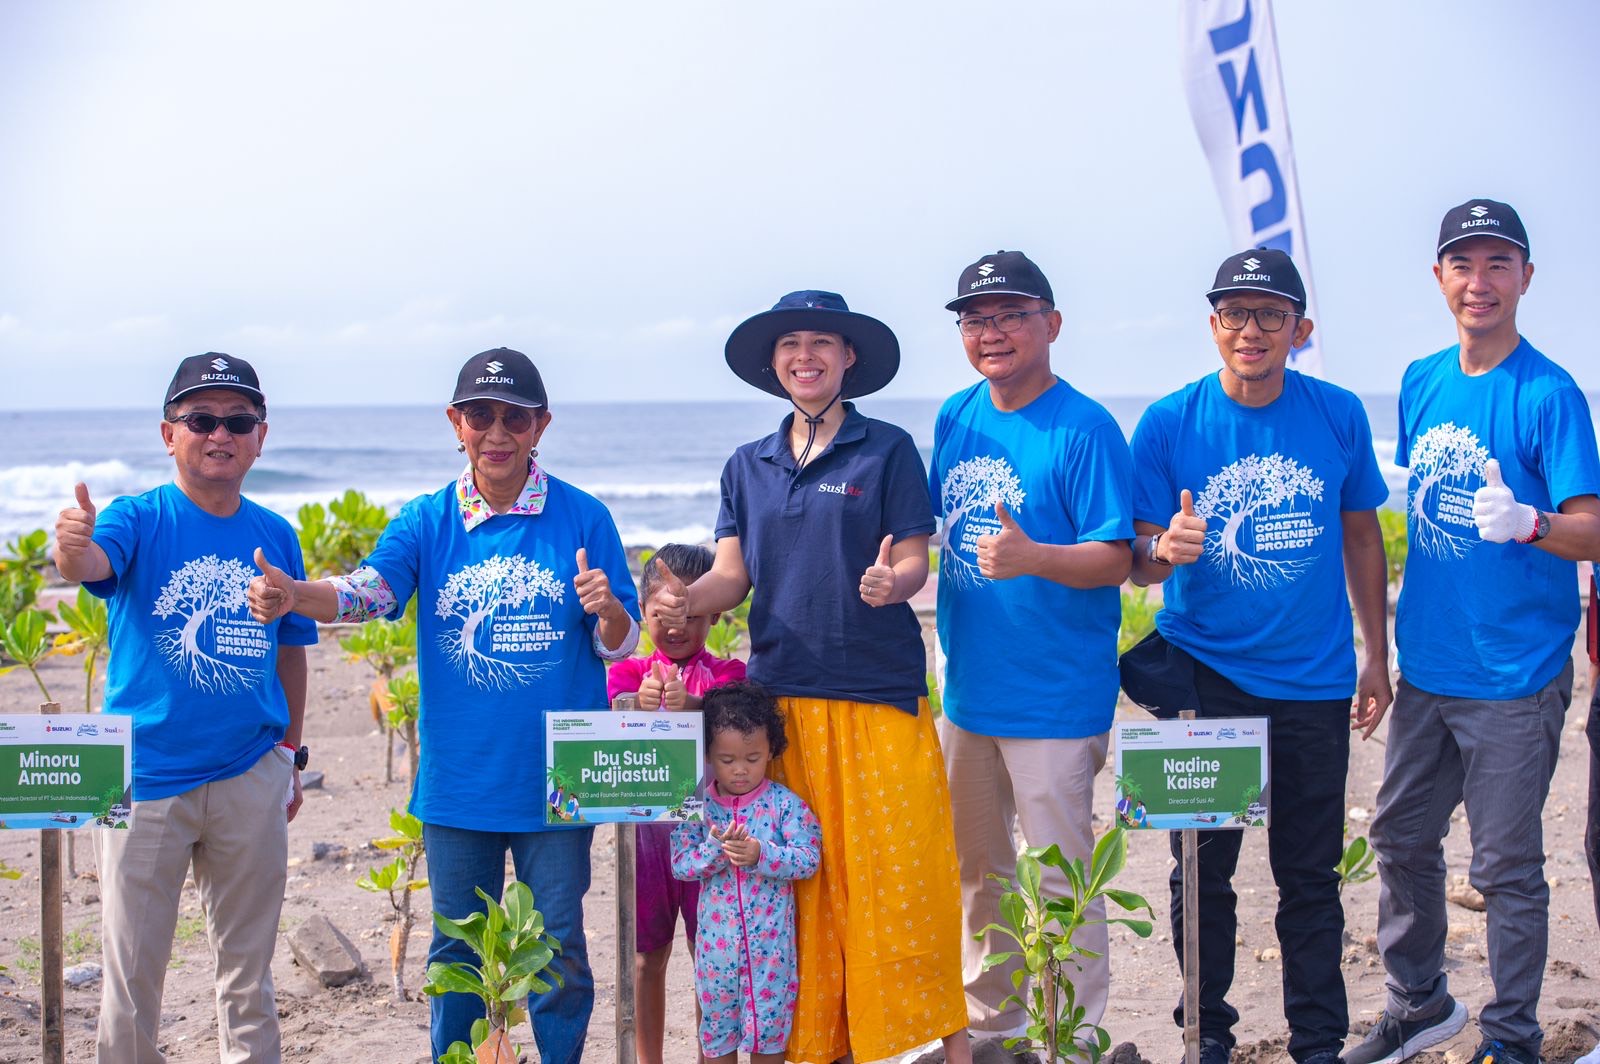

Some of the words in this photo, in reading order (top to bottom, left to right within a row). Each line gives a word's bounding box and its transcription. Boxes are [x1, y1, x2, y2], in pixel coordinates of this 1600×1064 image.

[1461, 218, 1500, 229] SUZUKI
[970, 276, 1006, 290] SUZUKI
[1232, 273, 1271, 282] SUZUKI
[201, 373, 240, 382] SUZUKI
[475, 376, 514, 384] SUZUKI
[1440, 492, 1474, 508] COASTA
[1269, 512, 1311, 520] INDONESIAN
[965, 524, 1001, 536] COAST
[1255, 519, 1314, 532] COASTAL
[1255, 526, 1325, 542] GREENBELT
[1256, 538, 1313, 552] PROJECT
[493, 622, 552, 632] COASTAL
[492, 631, 566, 642] GREENBELT
[217, 645, 267, 659] PROJECT
[492, 642, 551, 652] PROJECT
[20, 750, 80, 768] Minoru
[594, 750, 620, 766] Ibu
[623, 748, 657, 766] Susi
[1163, 756, 1220, 774] Nadine
[18, 769, 82, 785] Amano
[581, 765, 670, 788] Pudjiastuti
[1166, 773, 1218, 790] Kaiser
